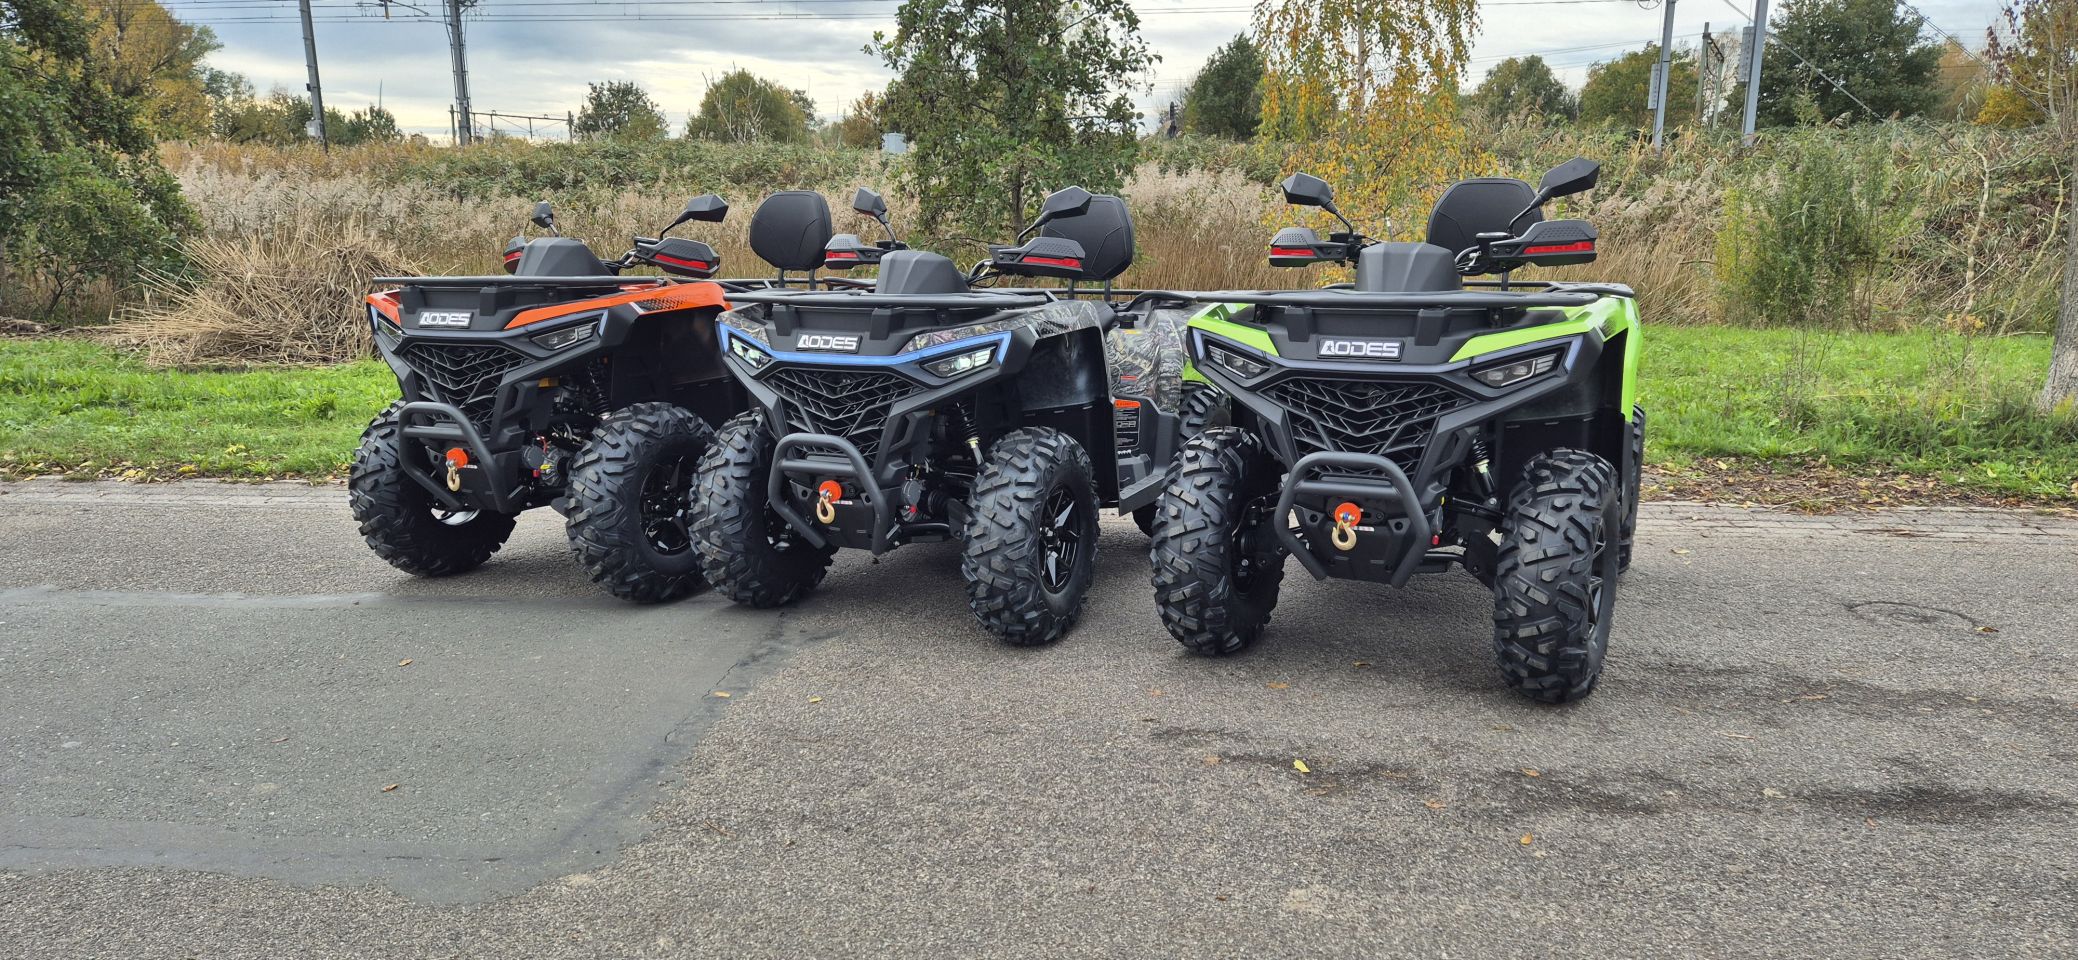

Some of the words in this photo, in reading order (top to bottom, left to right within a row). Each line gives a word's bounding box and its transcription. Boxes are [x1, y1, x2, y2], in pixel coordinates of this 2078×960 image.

[419, 311, 471, 325] AODES
[797, 334, 858, 350] AODES
[1320, 340, 1400, 357] AODES
